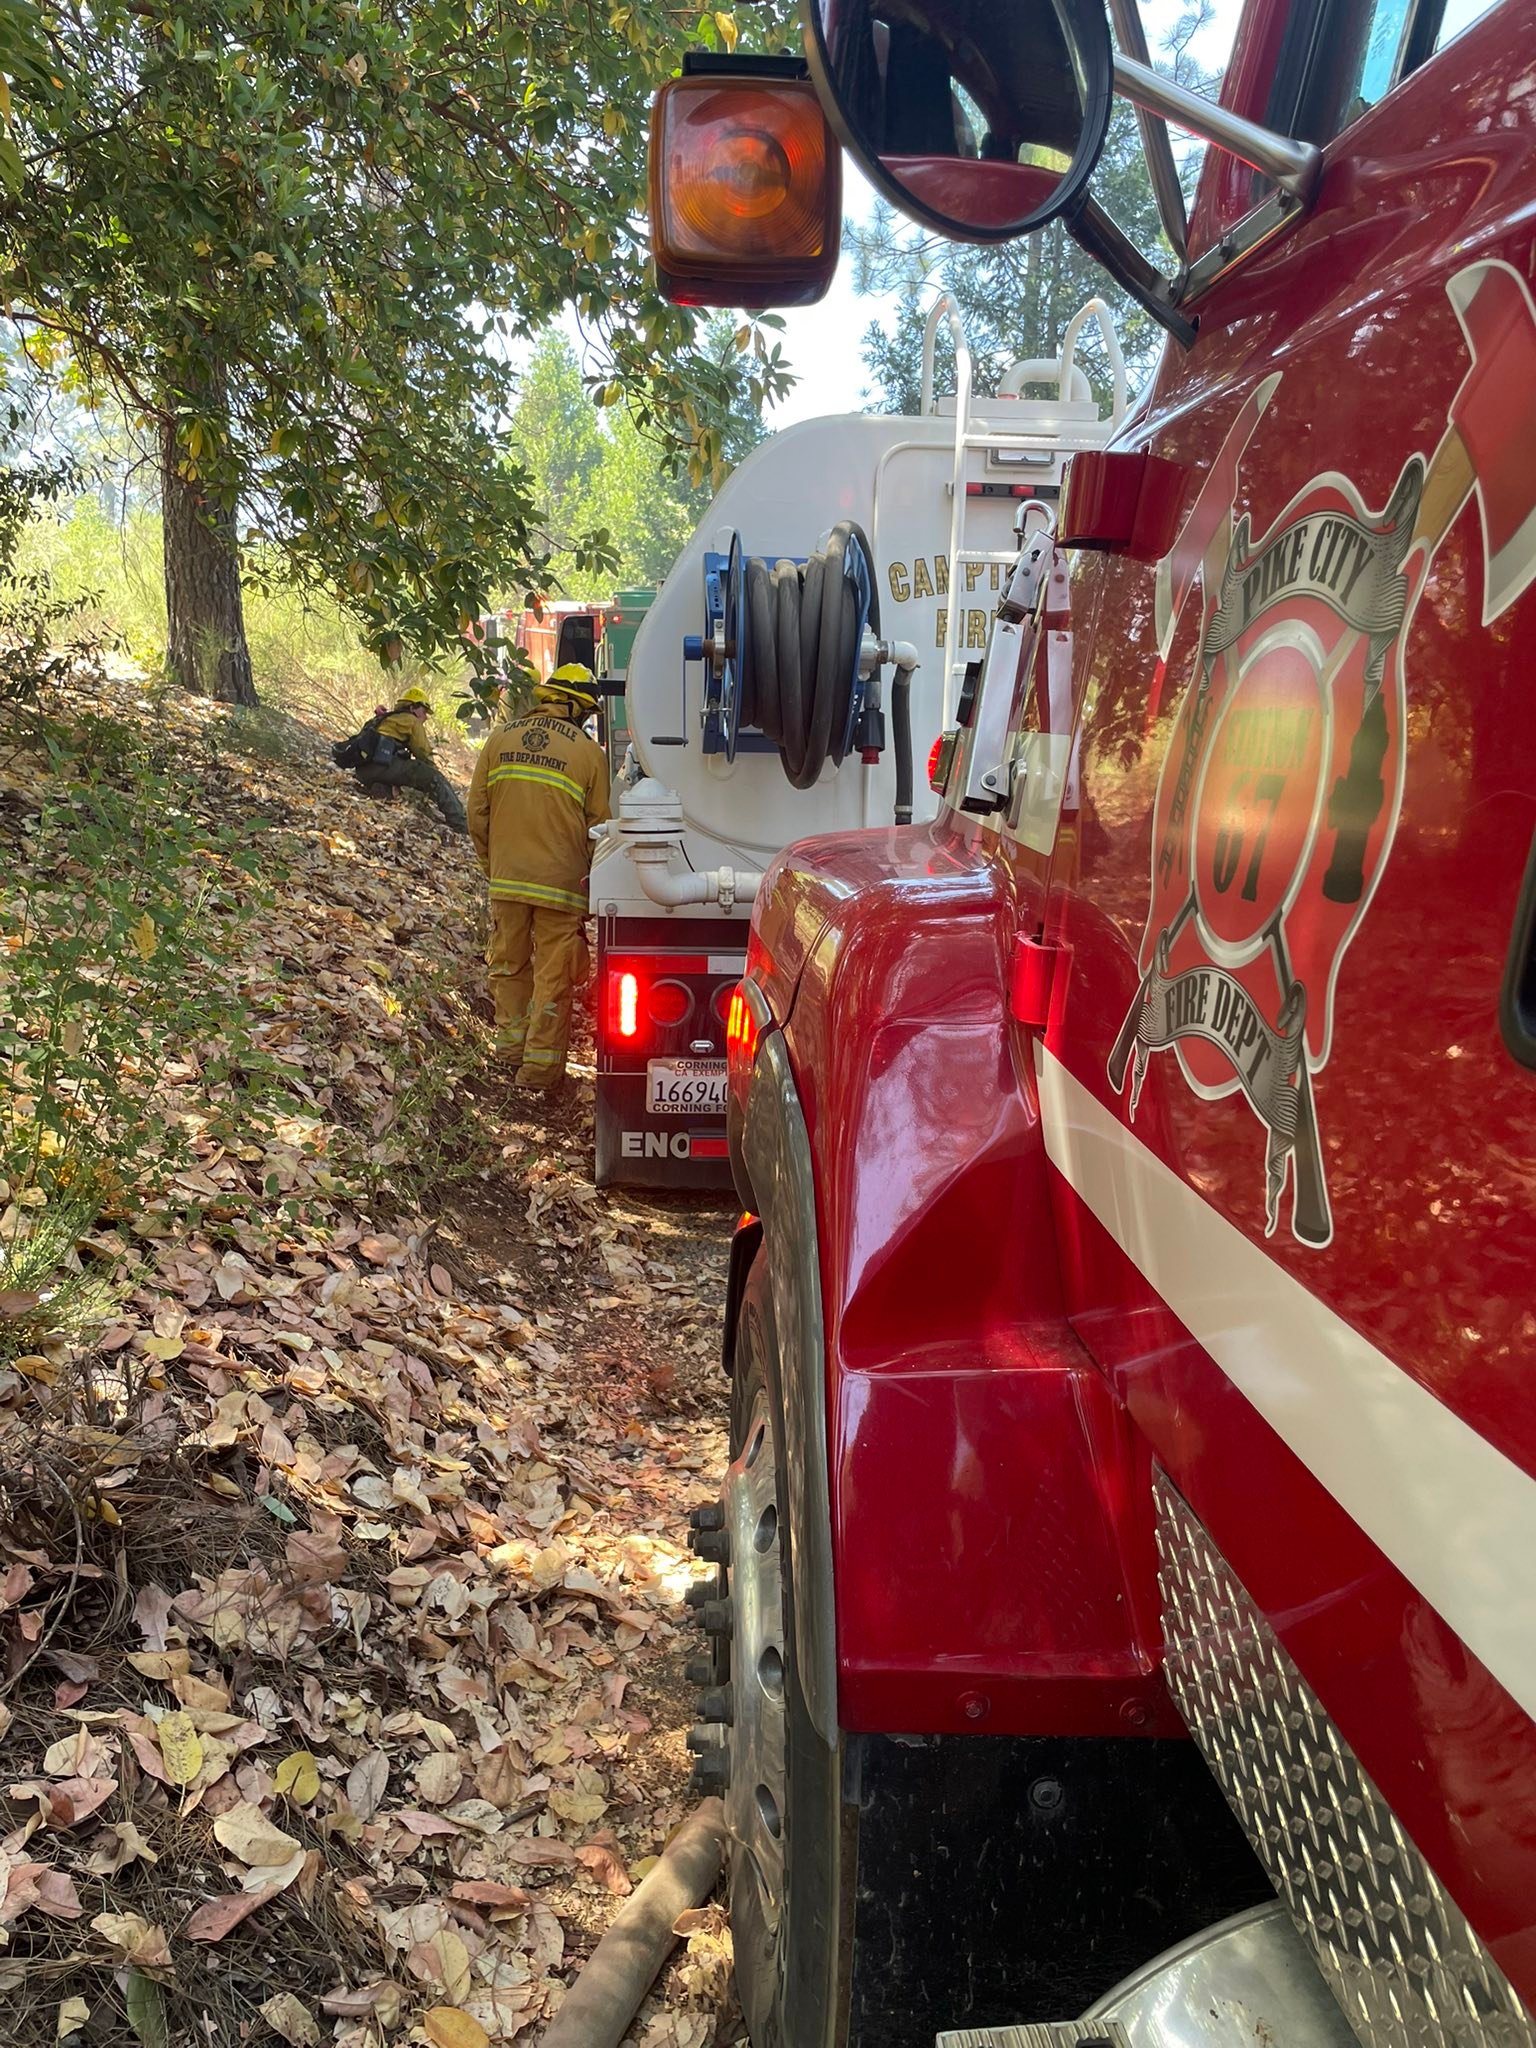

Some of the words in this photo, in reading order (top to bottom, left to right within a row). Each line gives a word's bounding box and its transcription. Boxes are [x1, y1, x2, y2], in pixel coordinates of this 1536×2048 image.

[1242, 524, 1309, 627] PIKE
[1308, 519, 1375, 606] CITY
[503, 717, 578, 742] CAMPTONVILLE
[500, 751, 515, 764] FIRE
[515, 752, 567, 772] DEPARTMENT
[1164, 973, 1211, 1037] FIRE
[1210, 977, 1272, 1086] DEPT
[653, 1103, 711, 1112] CORNING
